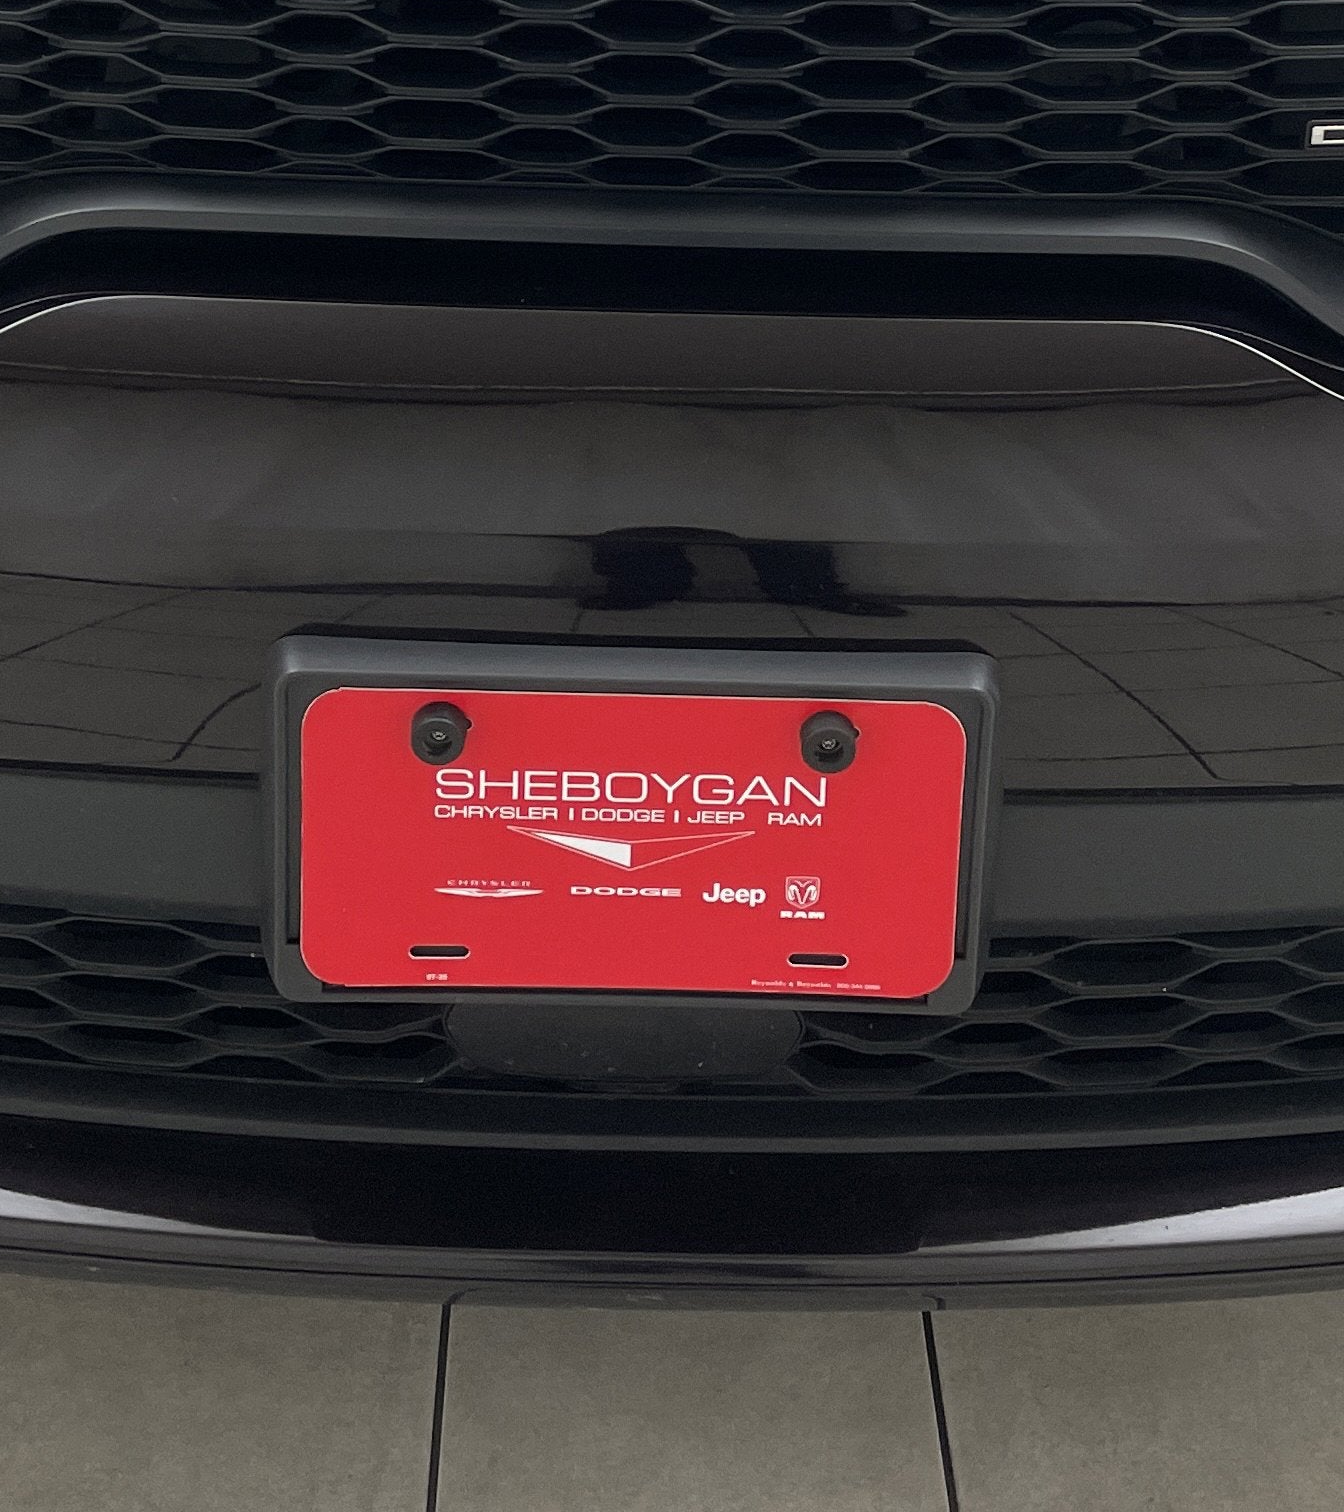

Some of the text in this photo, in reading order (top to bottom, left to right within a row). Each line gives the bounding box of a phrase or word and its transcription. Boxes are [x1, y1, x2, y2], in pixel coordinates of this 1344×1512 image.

[435, 768, 827, 807] SHEBOYGAN
[434, 804, 558, 821] CHRYSLER
[581, 808, 666, 823] DODGE
[687, 810, 745, 825] JEEP
[767, 811, 823, 827] RAM
[570, 885, 682, 897] DODGE
[702, 882, 767, 908] Jeep
[779, 910, 826, 920] RAM
